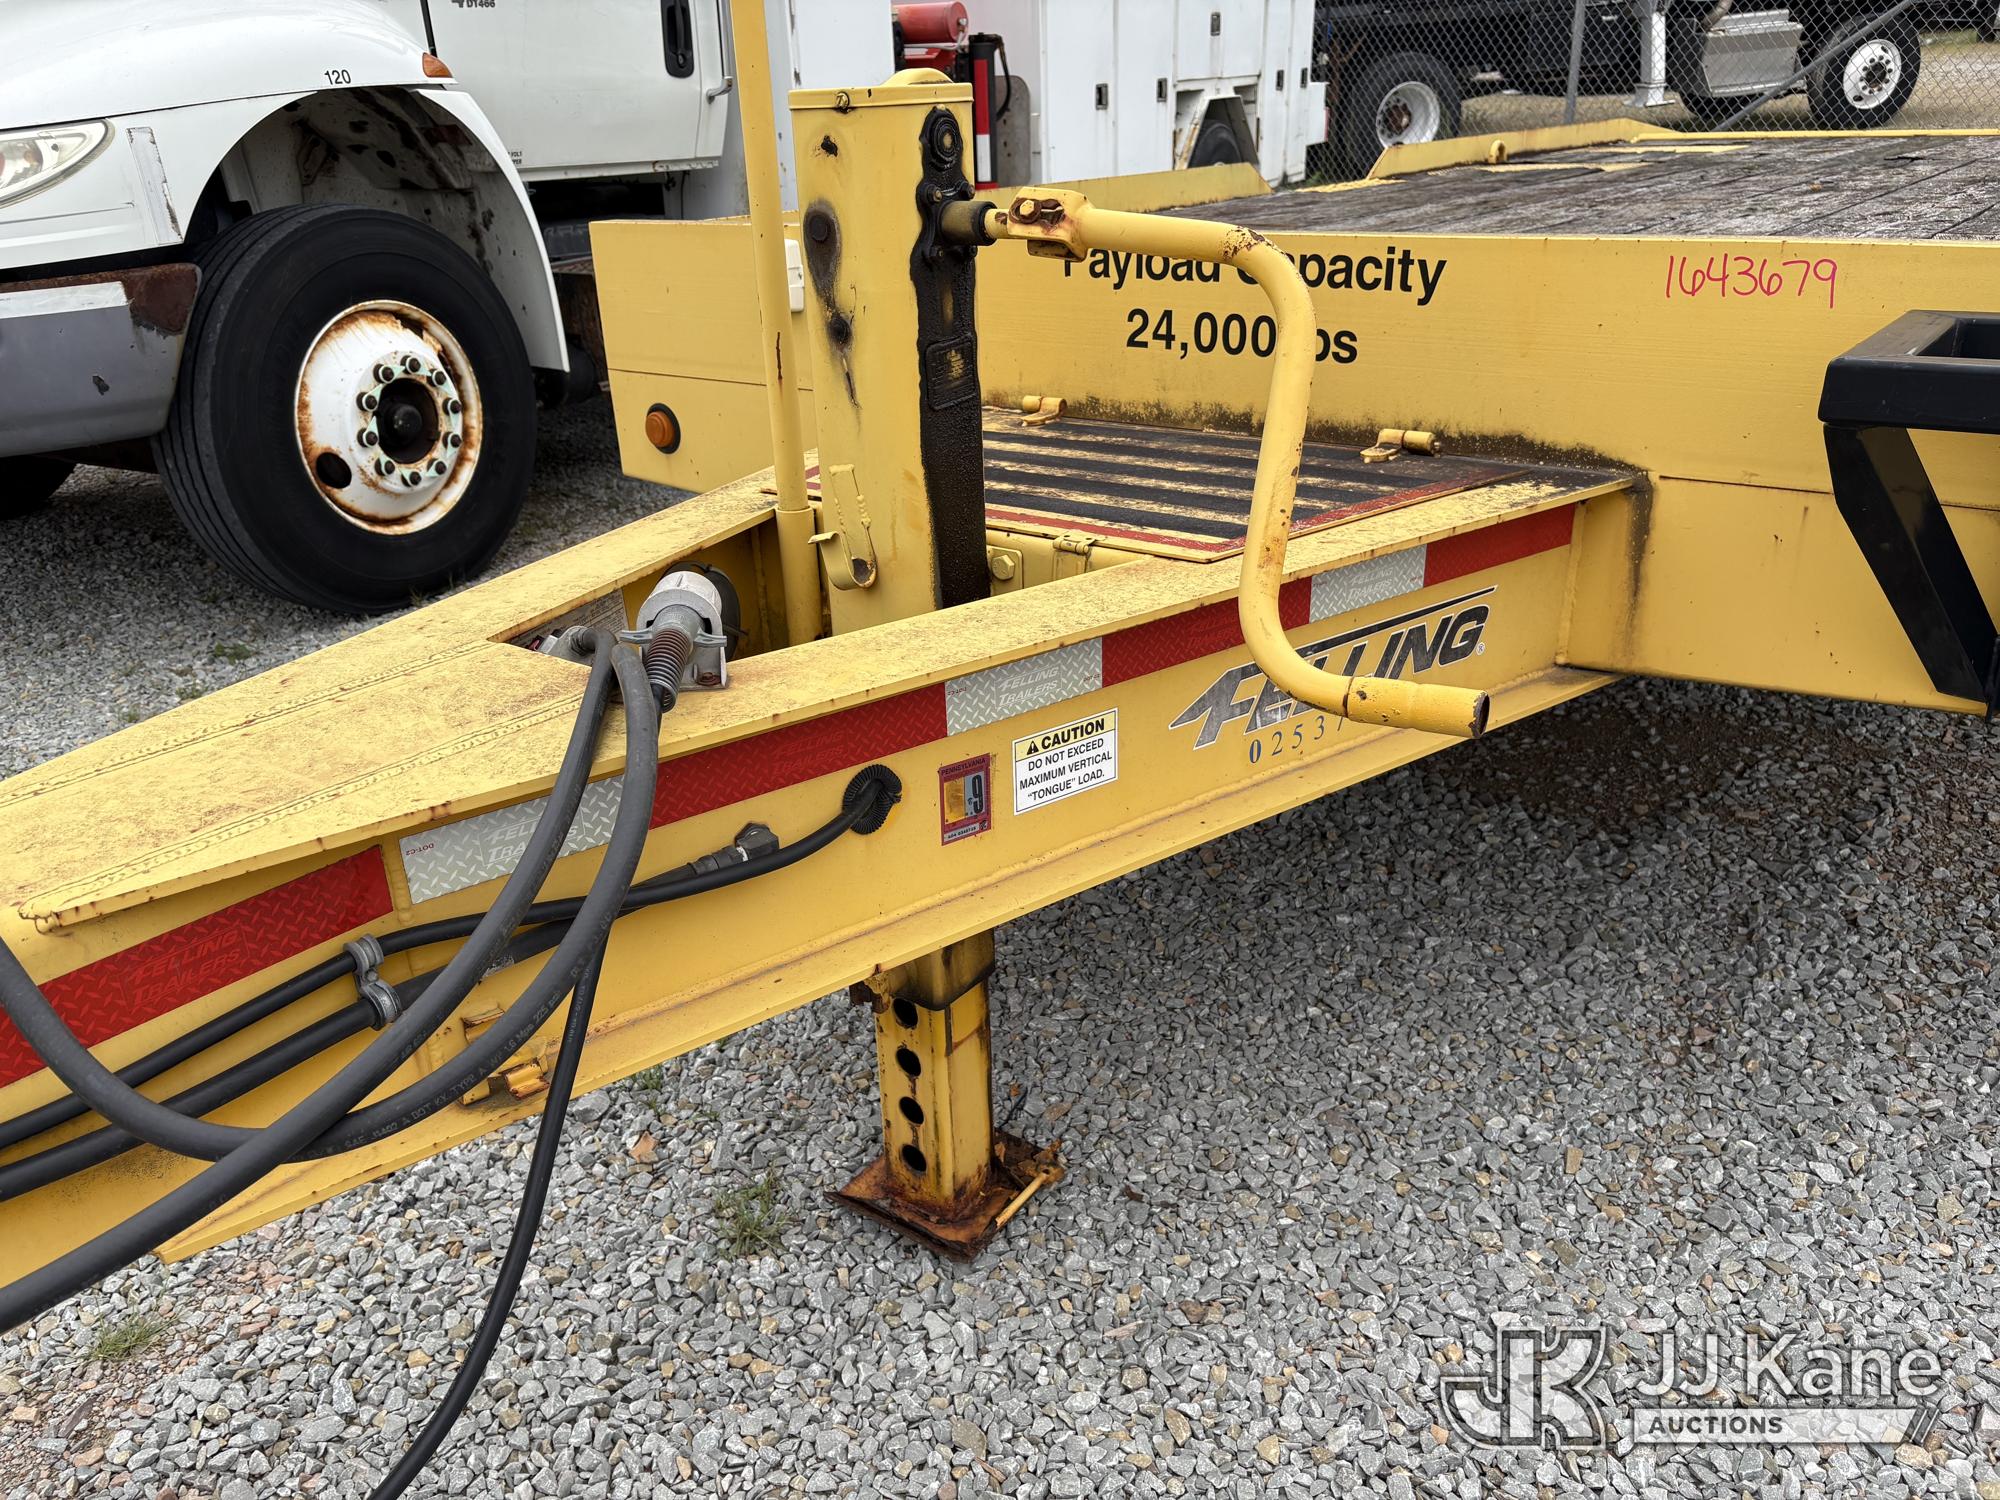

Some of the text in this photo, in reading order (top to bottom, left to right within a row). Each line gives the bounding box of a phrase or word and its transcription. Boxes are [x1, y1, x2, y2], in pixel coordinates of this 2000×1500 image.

[323, 69, 352, 85] 120
[1237, 246, 1448, 306] pacity
[1665, 252, 1838, 309] 1643679
[1126, 308, 1277, 360] 24,000
[998, 666, 1060, 692] FELLING
[999, 680, 1058, 707] TRAILERS
[1041, 718, 1105, 750] CAUTION
[941, 757, 986, 776] PENNSYLVANIA
[1019, 750, 1112, 790] MAXIMUM VERTICAL
[1028, 737, 1104, 772] DO NOT EXCEED
[1078, 768, 1105, 785] LOAD.
[971, 774, 984, 814] 9
